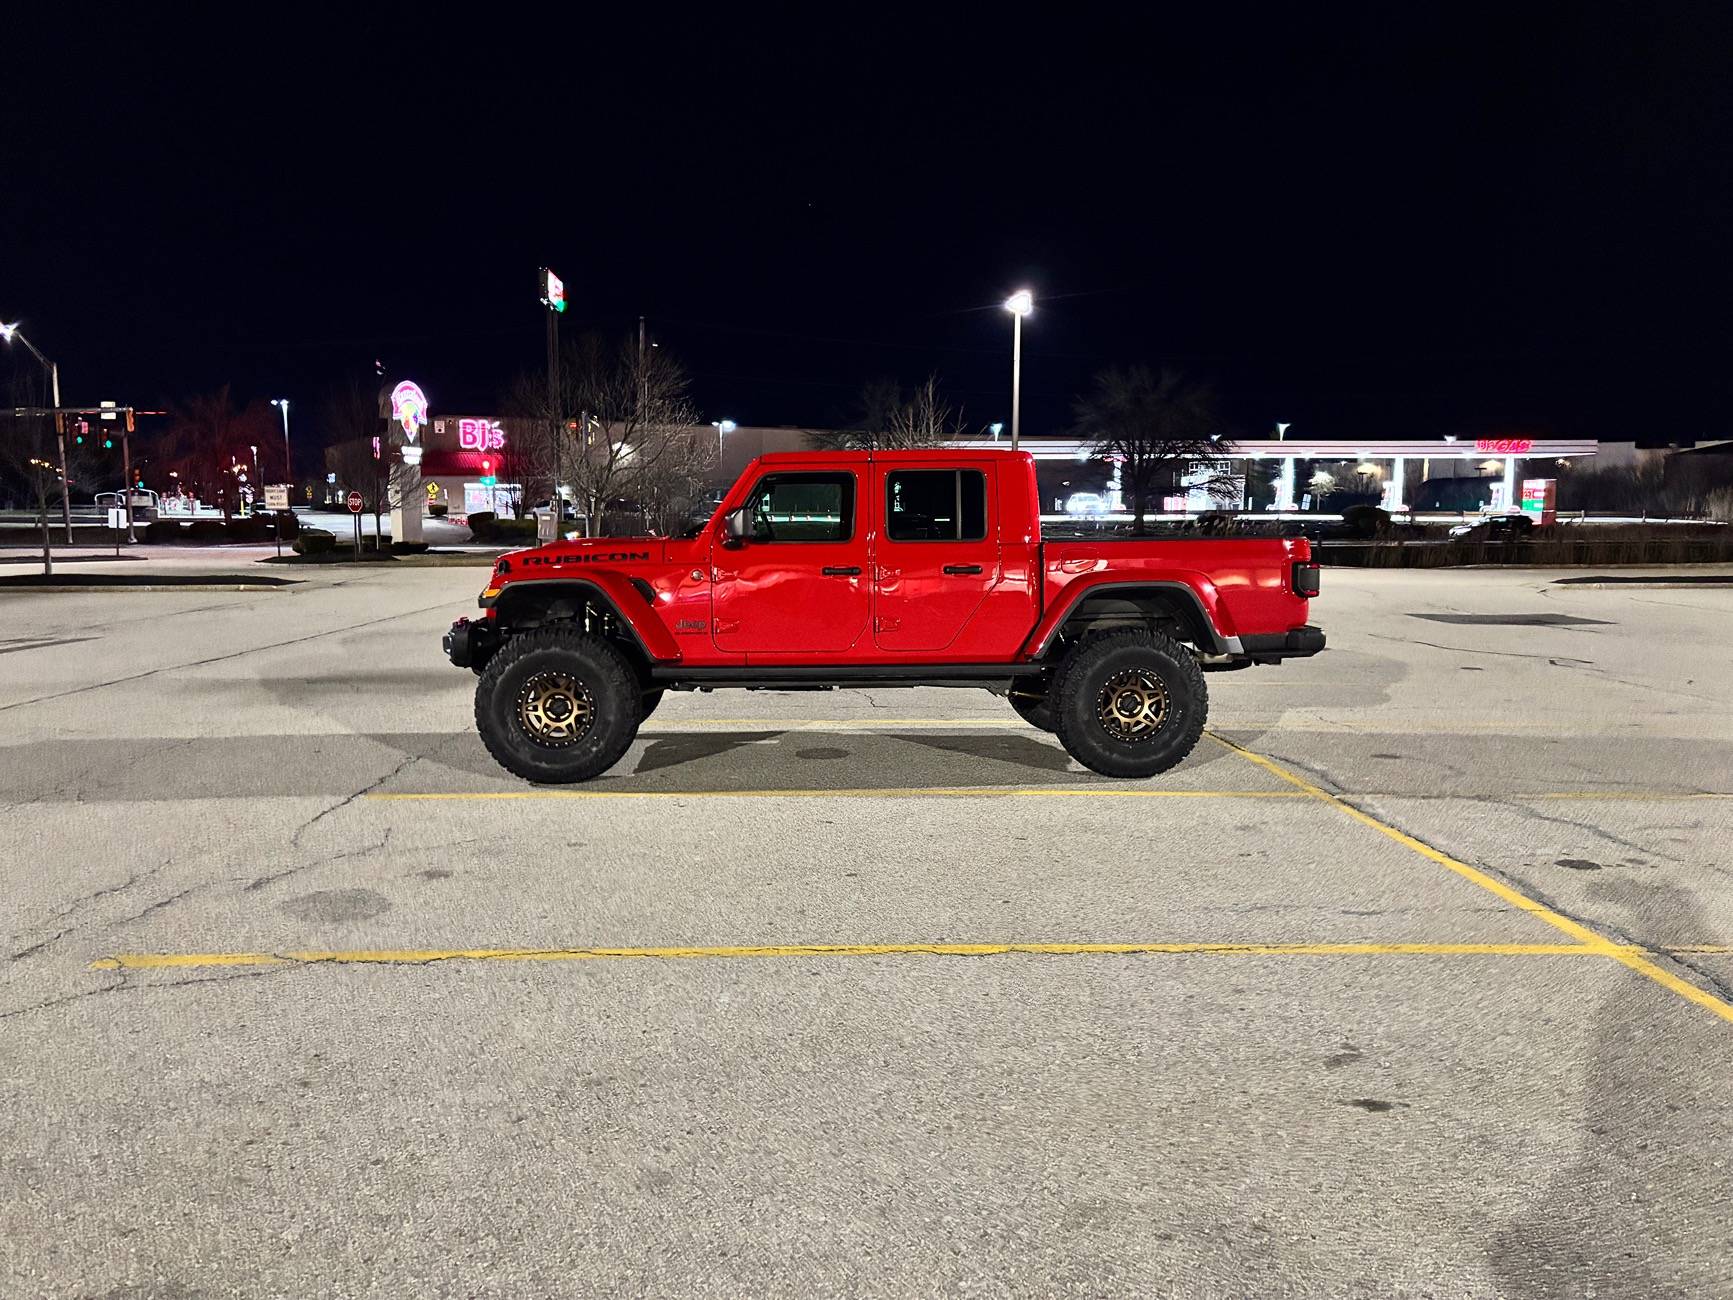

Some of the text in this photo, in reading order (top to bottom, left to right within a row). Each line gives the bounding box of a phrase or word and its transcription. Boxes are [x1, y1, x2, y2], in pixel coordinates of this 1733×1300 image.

[1496, 440, 1531, 453] GAS
[349, 498, 361, 506] STOP
[523, 552, 649, 565] RUBICON
